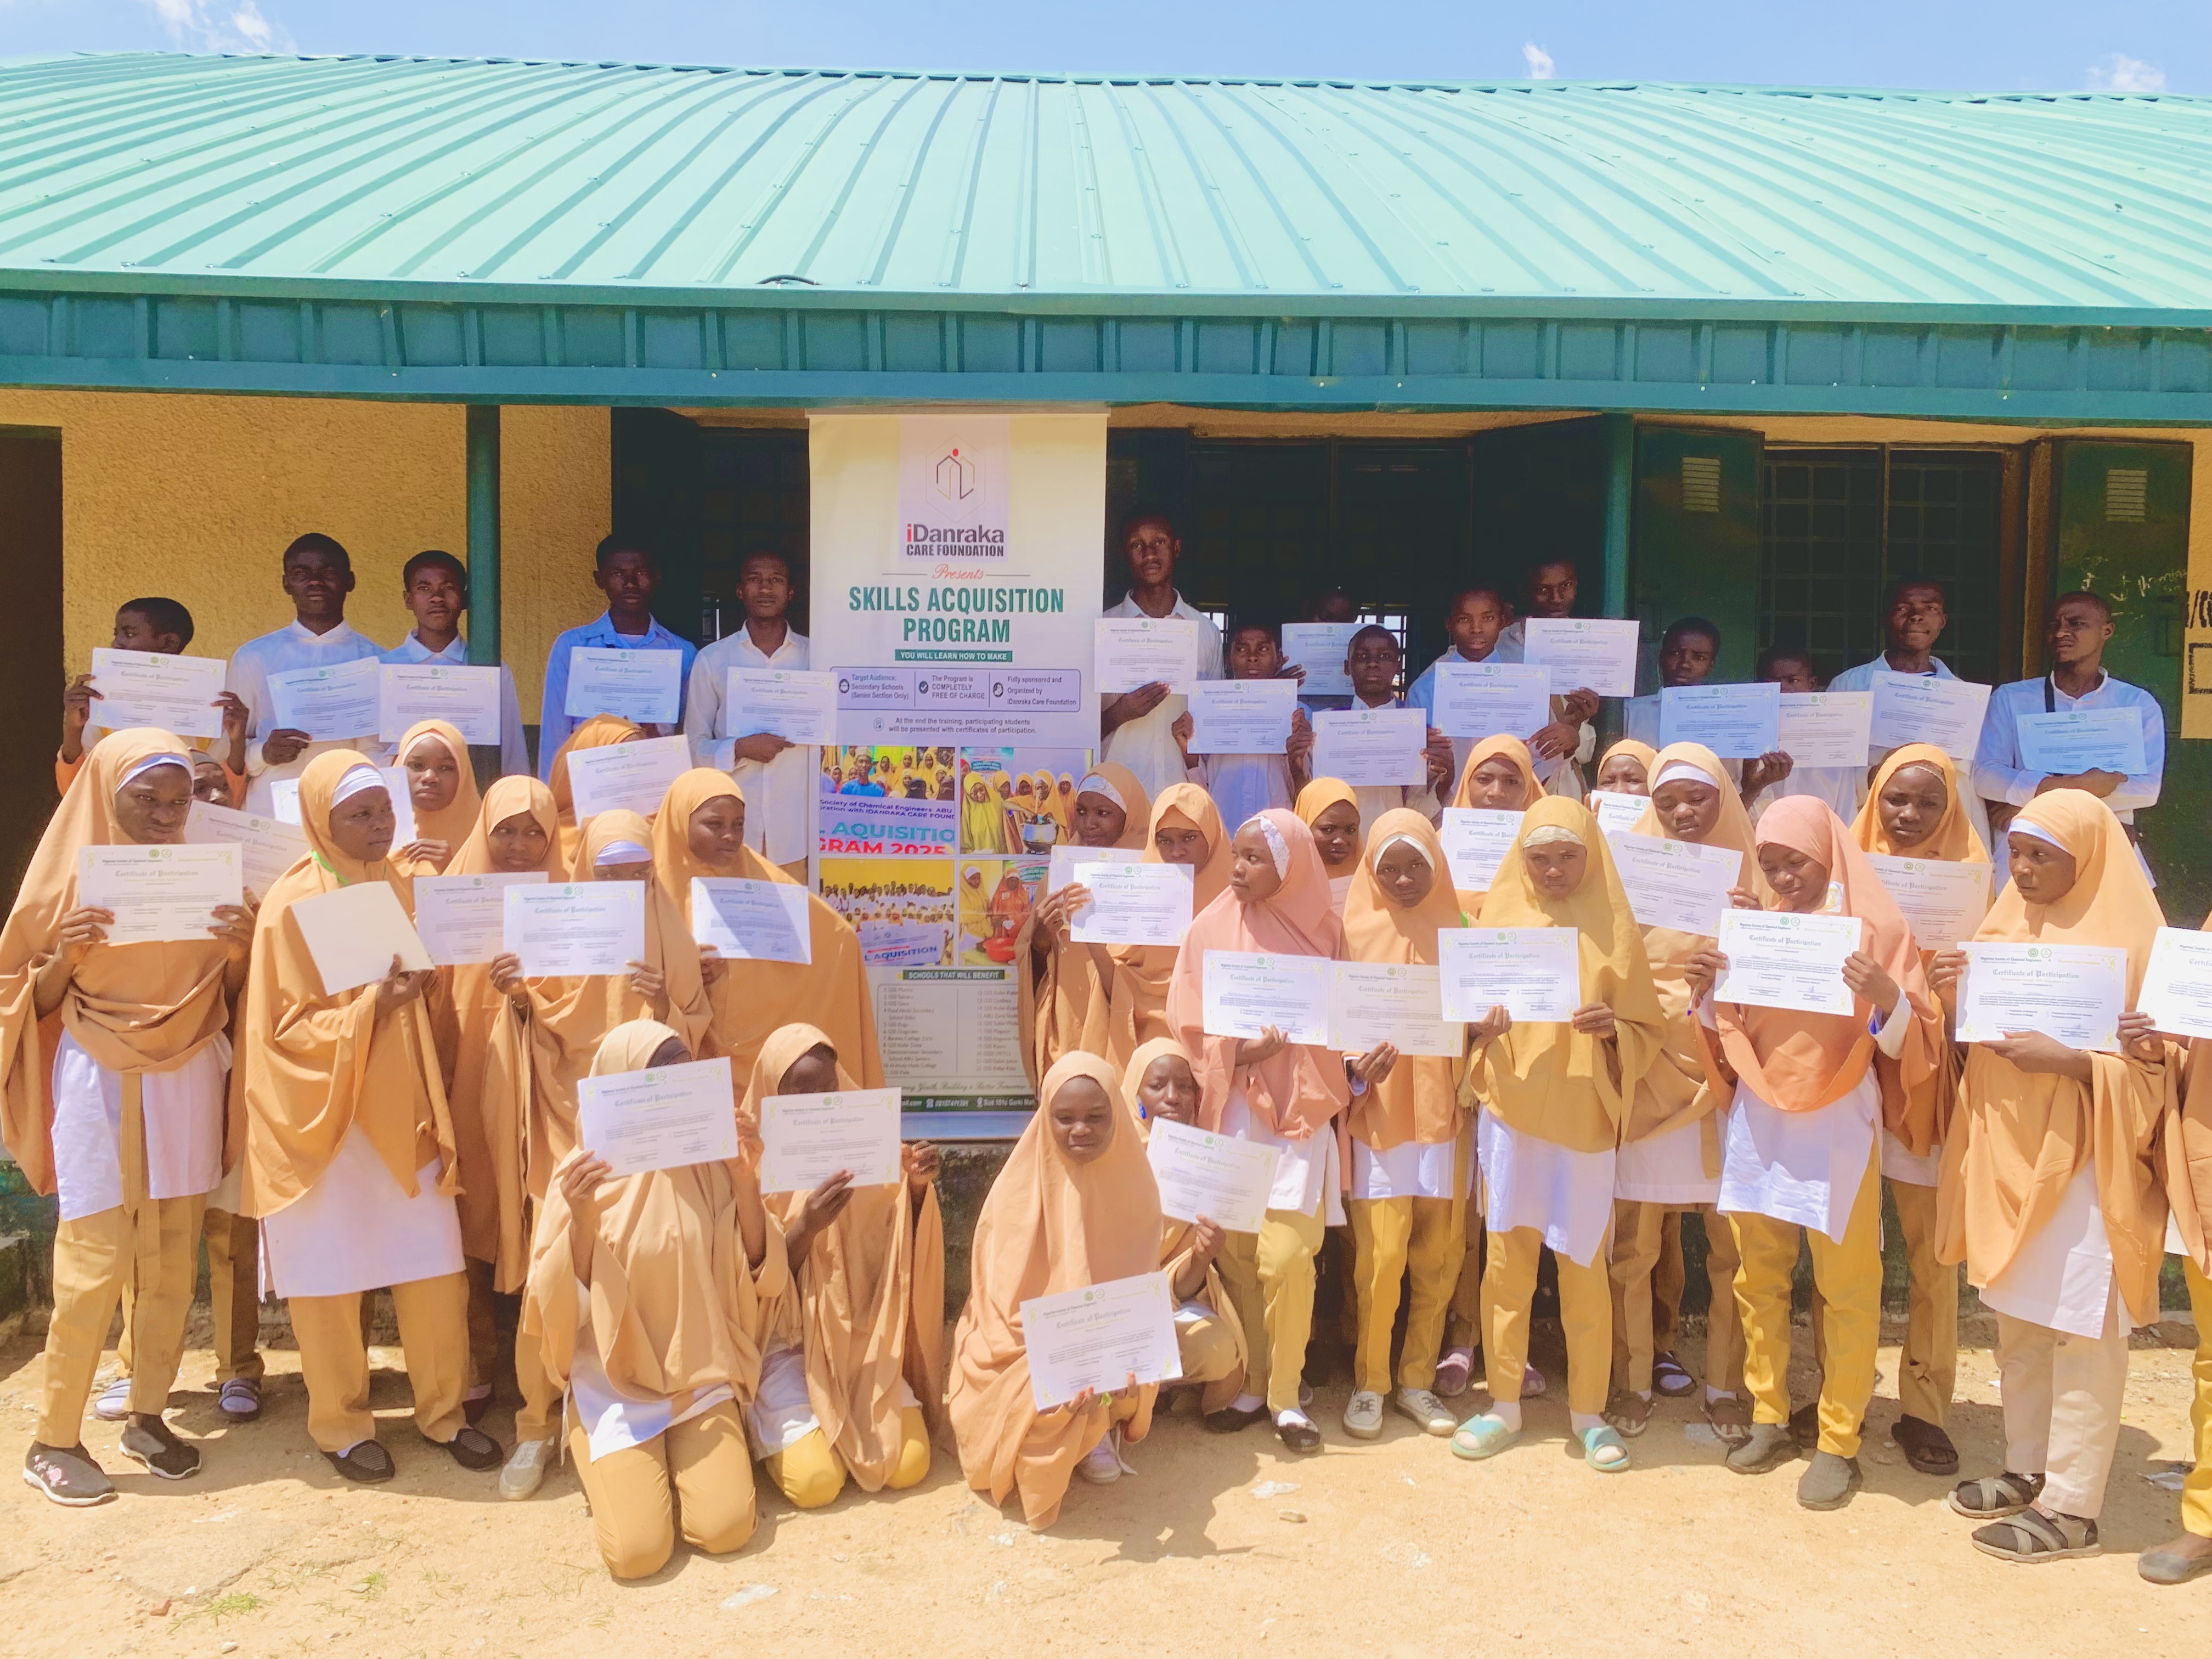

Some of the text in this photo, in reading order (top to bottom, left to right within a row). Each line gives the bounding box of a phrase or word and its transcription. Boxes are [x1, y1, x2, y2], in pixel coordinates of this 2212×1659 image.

[907, 523, 1005, 543] iDanraka
[906, 544, 1004, 557] CARE FOUNDATION
[932, 563, 984, 580] Presents
[849, 586, 1064, 615] SKILLS ACQUISITION
[903, 618, 1010, 642] PROGRAM
[900, 651, 916, 659] YOU
[934, 652, 958, 660] LEARN
[977, 652, 986, 661] TO
[987, 652, 1007, 661] MAKE
[858, 802, 893, 810] Chemical
[895, 805, 933, 813] Engineers
[831, 821, 955, 843] AQUISITIO
[890, 843, 946, 854] 2025
[1632, 856, 1658, 867] Certificate
[1667, 862, 1701, 873] Participation
[1909, 882, 1948, 891] Participation
[1749, 934, 1777, 943] Certificate
[1785, 937, 1821, 946] Participation
[873, 945, 938, 961] AQUISITION
[2035, 970, 2080, 979] Participation
[1393, 987, 1428, 995] Participation
[614, 1097, 645, 1108] Certificate
[1056, 1318, 1086, 1329] Certificate
[1094, 1308, 1132, 1321] Participation
